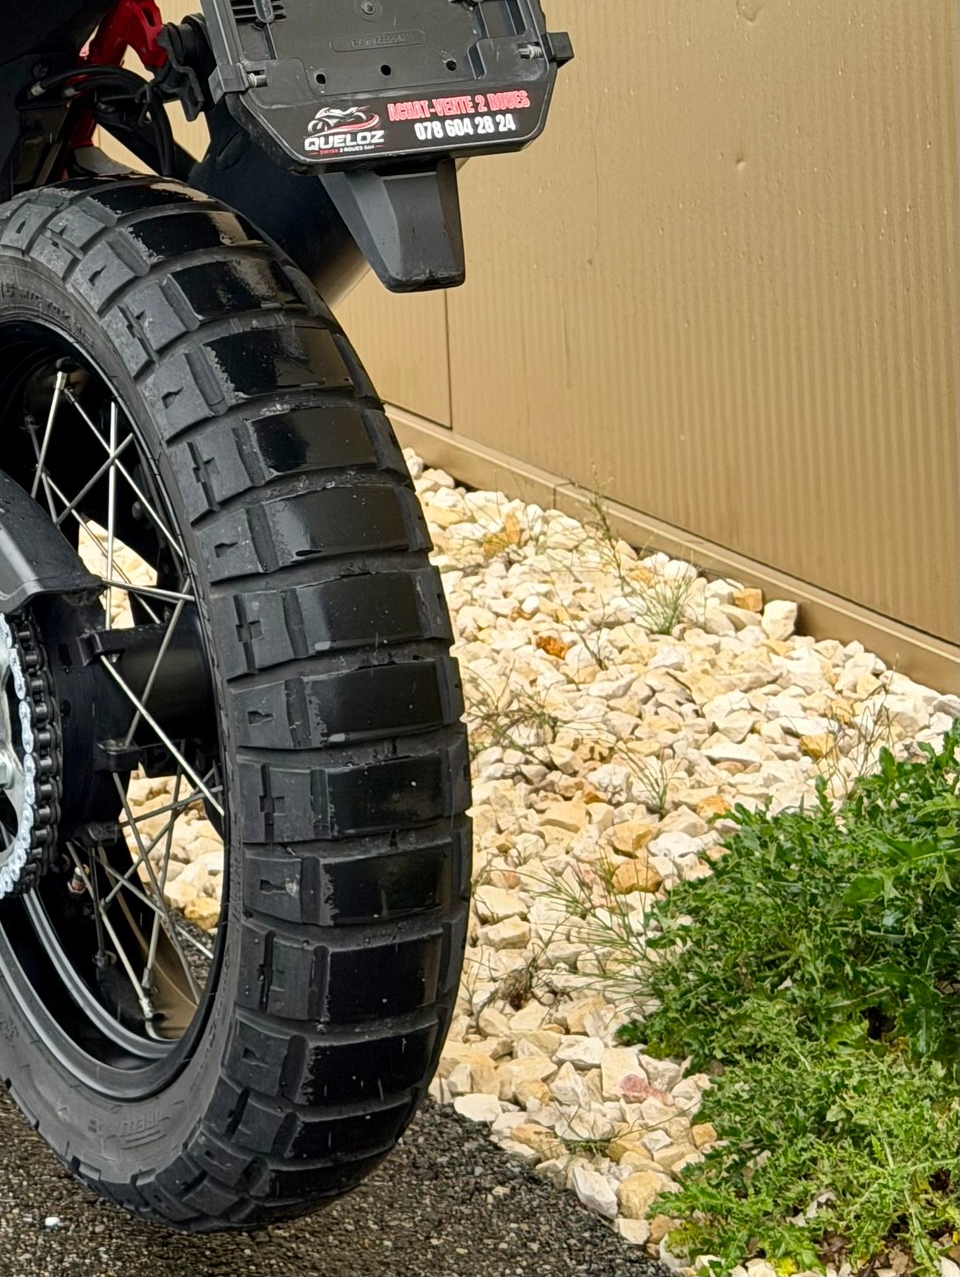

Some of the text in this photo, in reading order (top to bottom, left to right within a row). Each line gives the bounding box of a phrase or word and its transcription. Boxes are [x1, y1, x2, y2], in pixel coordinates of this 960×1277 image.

[476, 97, 487, 113] 2
[414, 113, 517, 141] 078 604 28 24
[304, 130, 385, 151] QUELOZ
